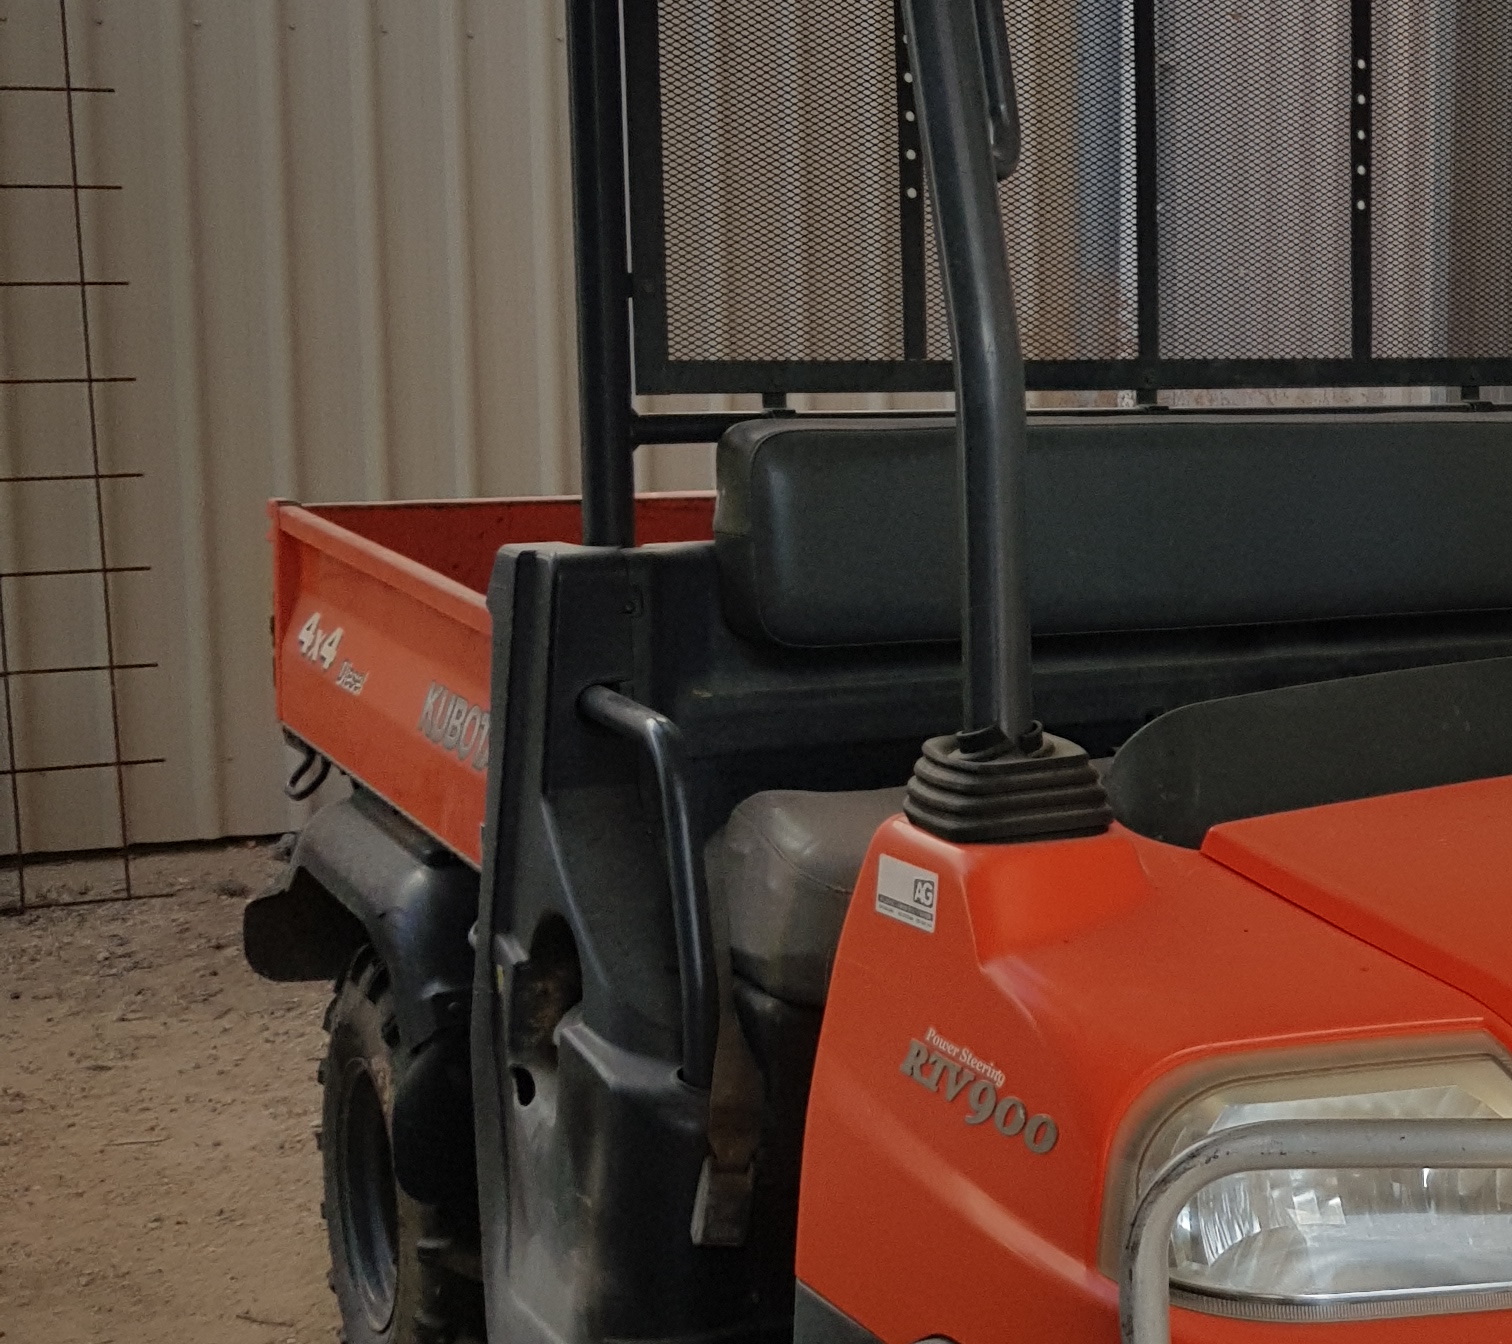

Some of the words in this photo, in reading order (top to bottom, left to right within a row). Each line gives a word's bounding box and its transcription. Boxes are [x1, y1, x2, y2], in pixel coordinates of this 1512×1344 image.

[298, 612, 344, 669] 4x4
[417, 680, 490, 770] KUBOT
[914, 881, 933, 906] AG
[924, 1026, 960, 1057] Power
[959, 1047, 1006, 1088] Steering
[900, 1038, 1059, 1154] RTV900
